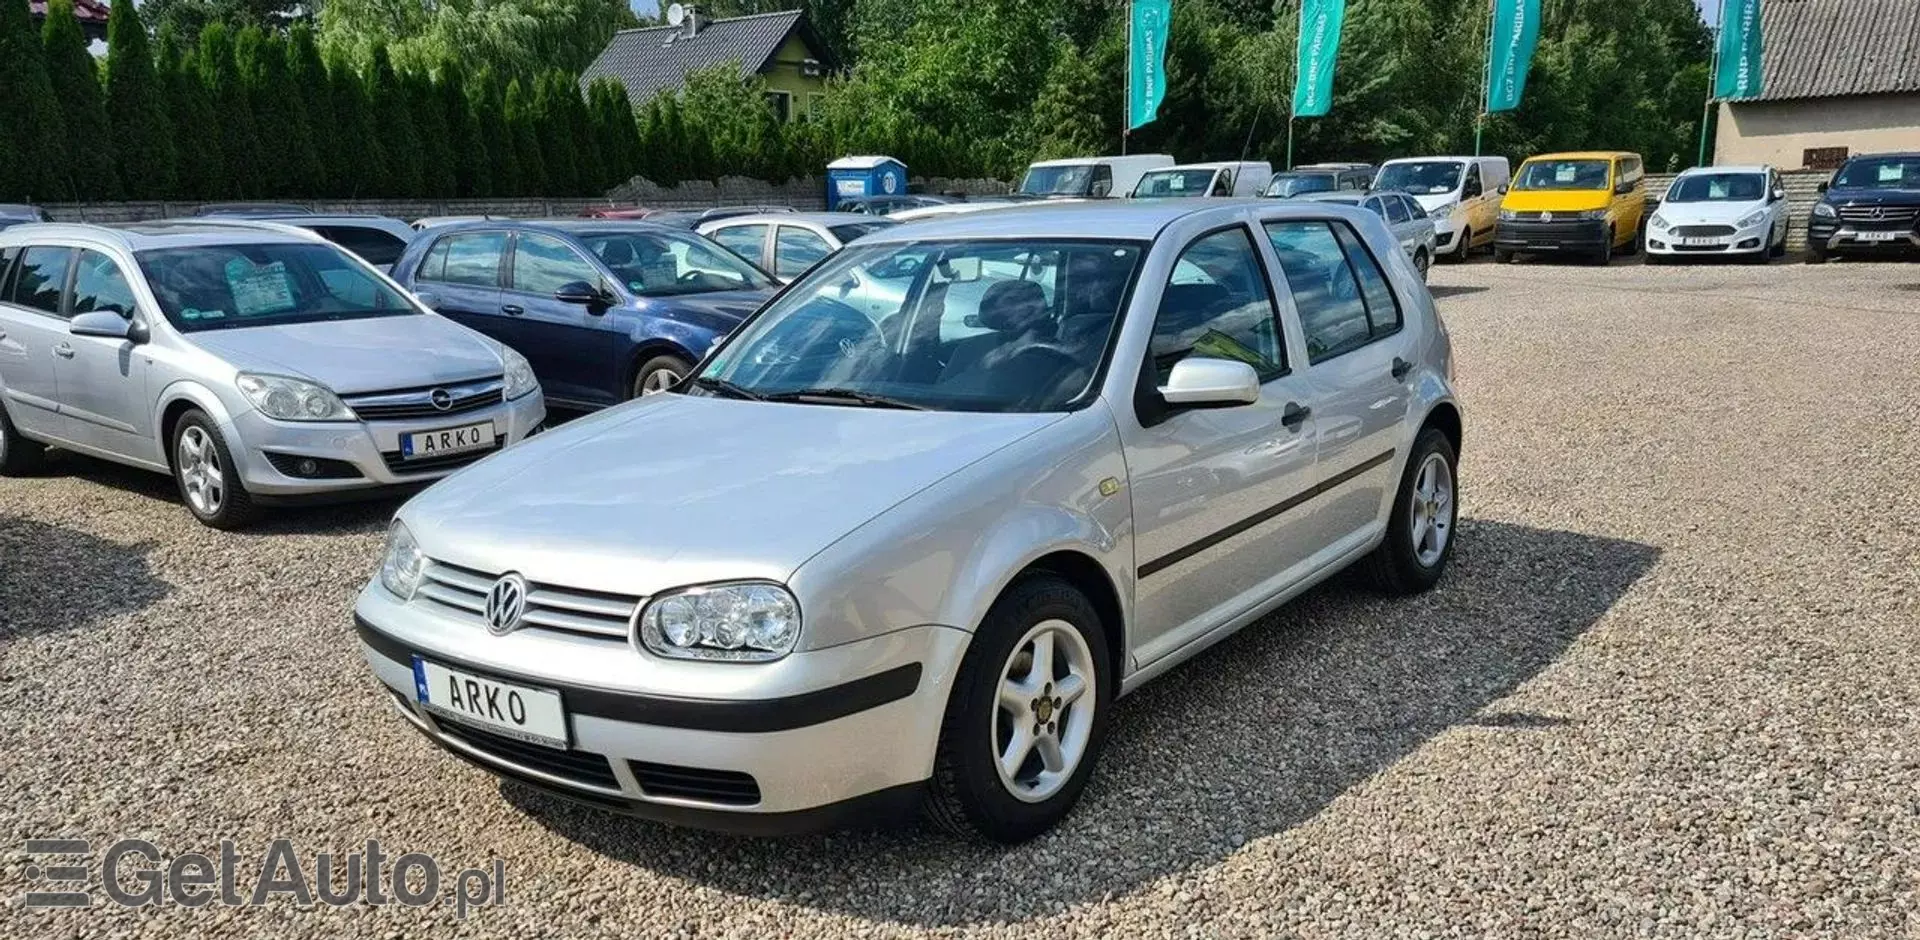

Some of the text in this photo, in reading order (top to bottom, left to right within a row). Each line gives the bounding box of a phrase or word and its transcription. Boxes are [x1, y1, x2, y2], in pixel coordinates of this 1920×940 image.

[1308, 58, 1318, 81] BNP
[1145, 75, 1153, 97] BNP
[425, 428, 480, 451] ARKO
[450, 675, 526, 725] ARKO
